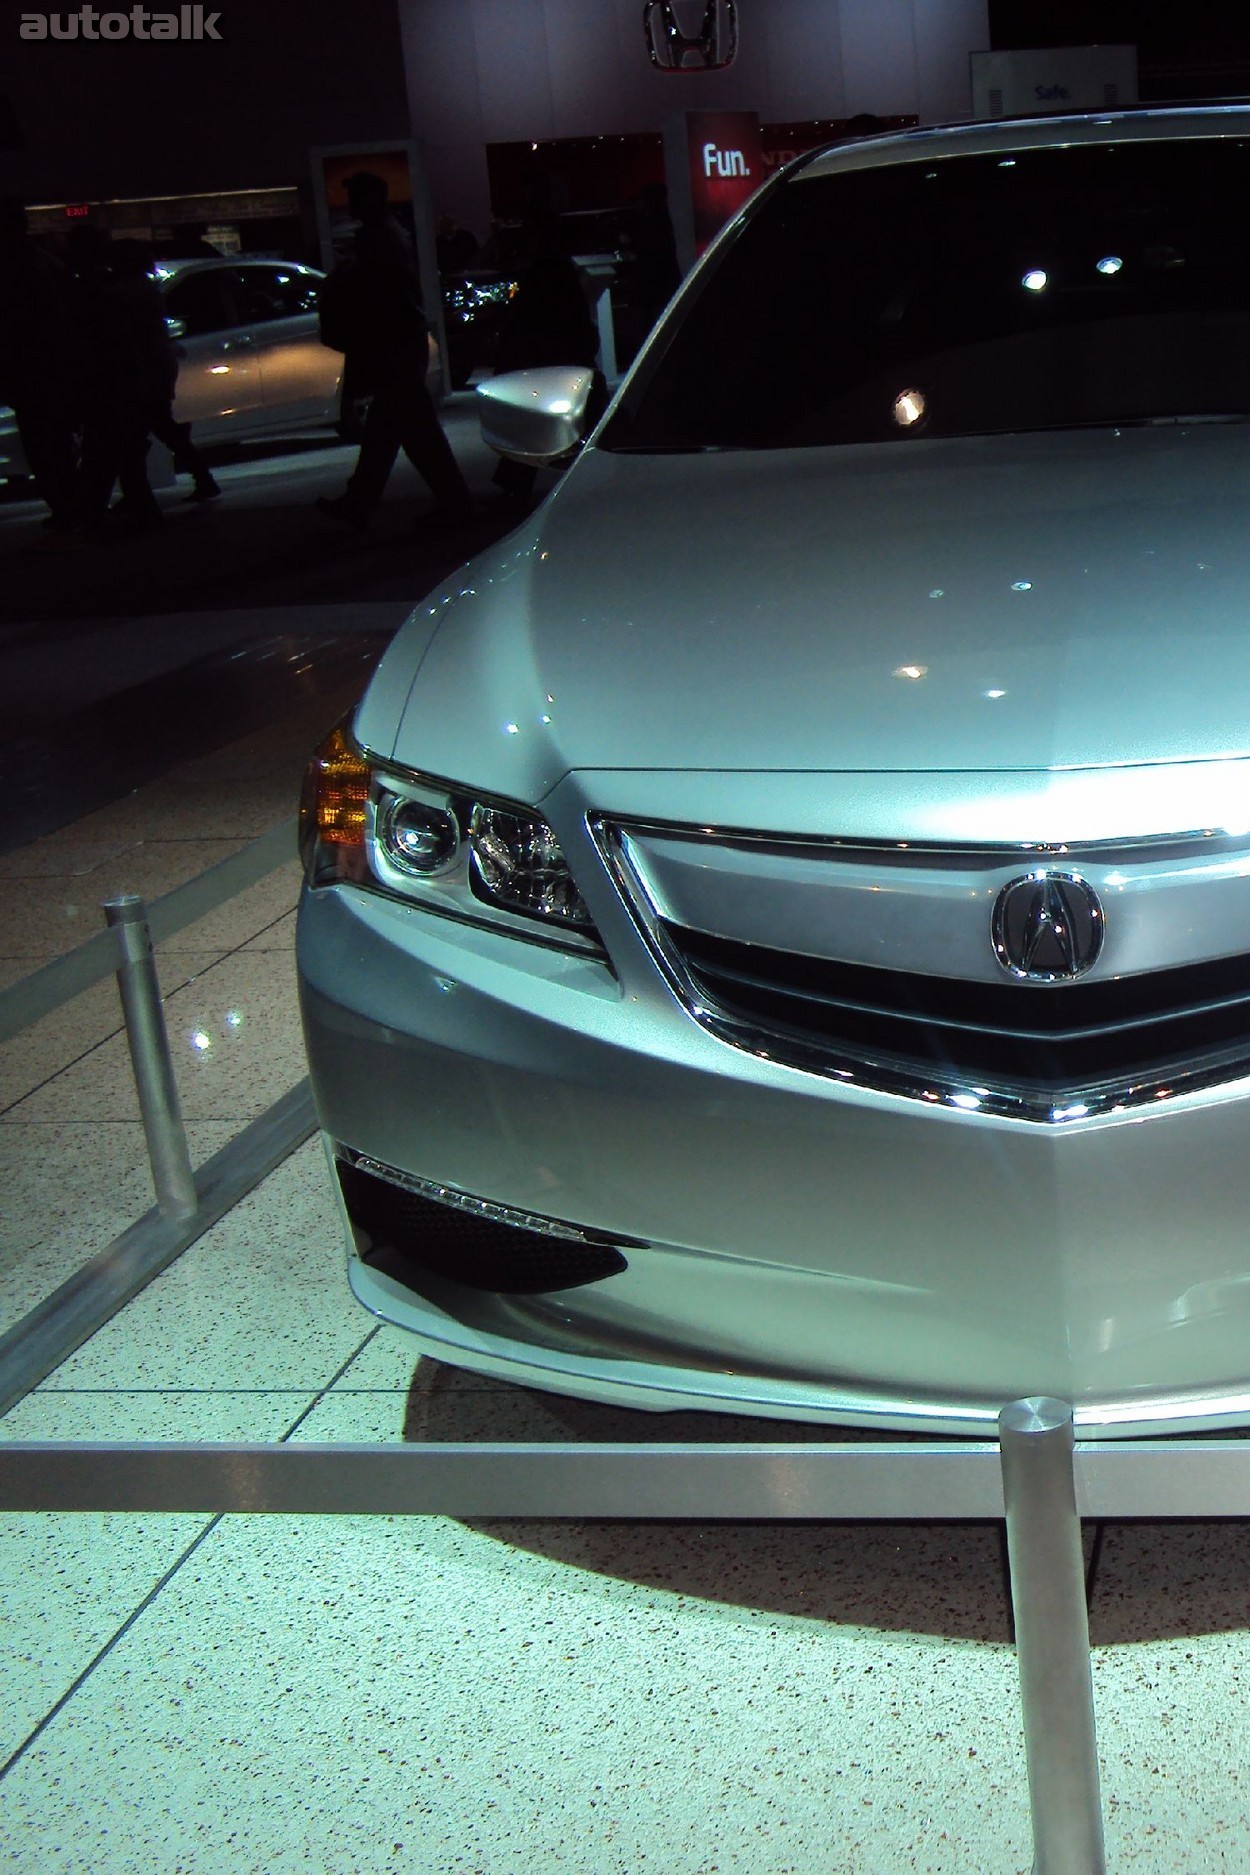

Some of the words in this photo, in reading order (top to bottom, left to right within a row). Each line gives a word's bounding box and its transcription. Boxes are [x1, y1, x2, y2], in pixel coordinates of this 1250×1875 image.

[1034, 83, 1072, 100] Safe.
[703, 143, 751, 177] Fun.
[67, 206, 89, 217] EXIT
